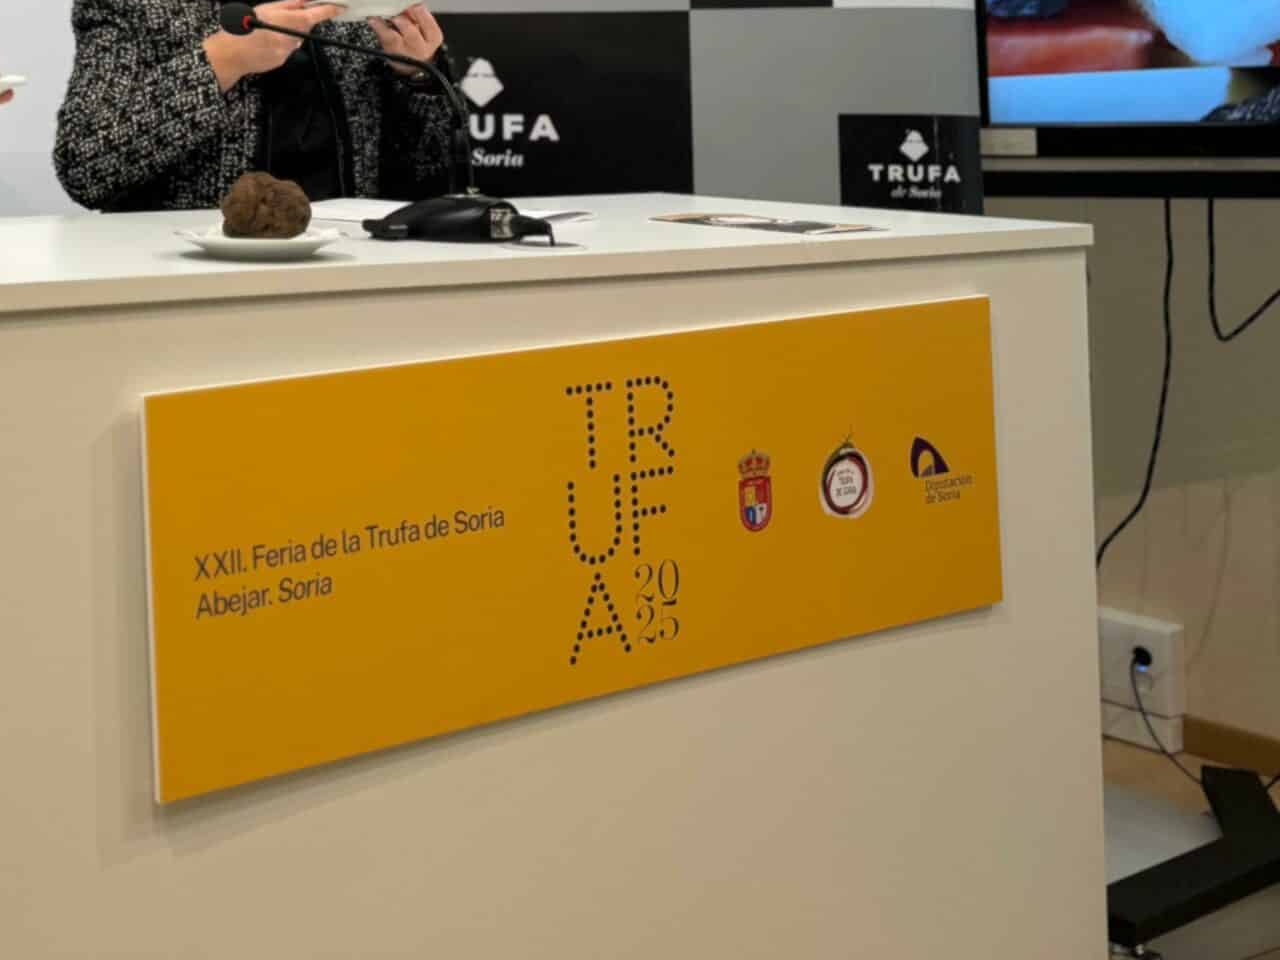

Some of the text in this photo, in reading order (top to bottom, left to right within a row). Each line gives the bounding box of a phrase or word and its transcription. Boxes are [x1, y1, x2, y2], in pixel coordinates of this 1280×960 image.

[470, 113, 561, 143] UFA
[471, 147, 525, 168] Soria
[868, 163, 961, 183] TRUFA
[193, 505, 506, 581] XXII. Feria de la Trufa de Soria
[195, 573, 333, 620] Abejar. Soria
